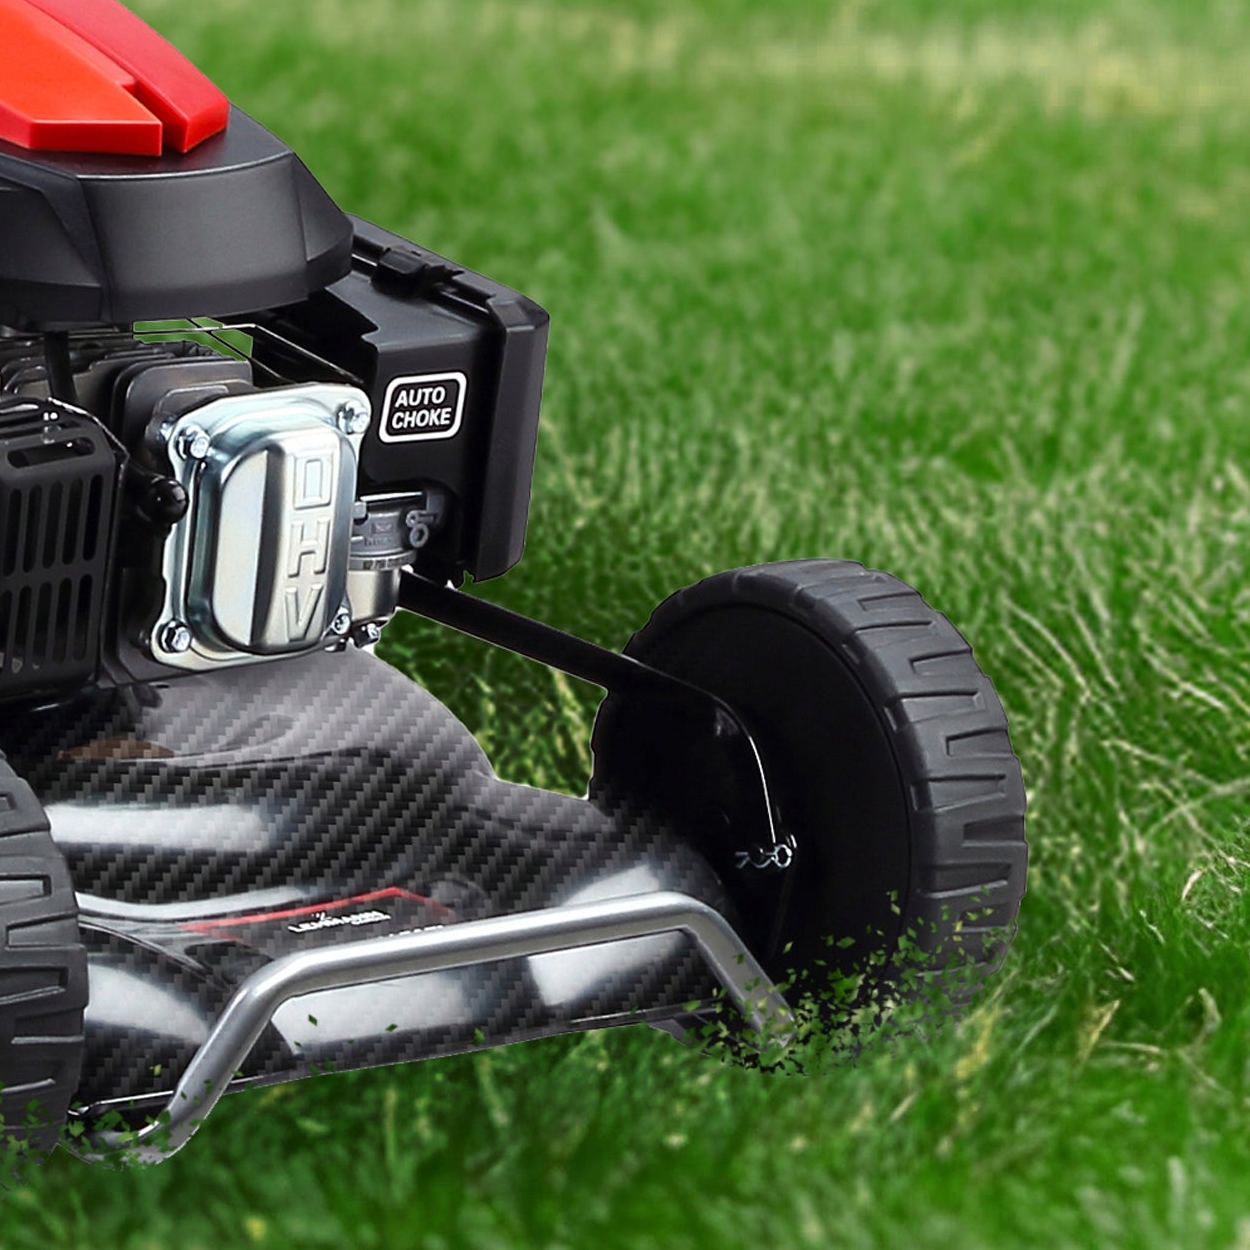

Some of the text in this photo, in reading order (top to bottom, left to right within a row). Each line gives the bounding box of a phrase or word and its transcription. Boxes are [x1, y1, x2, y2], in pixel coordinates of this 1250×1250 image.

[394, 386, 446, 408] AUTO
[391, 407, 452, 429] CHOKE
[284, 451, 336, 644] OHV
